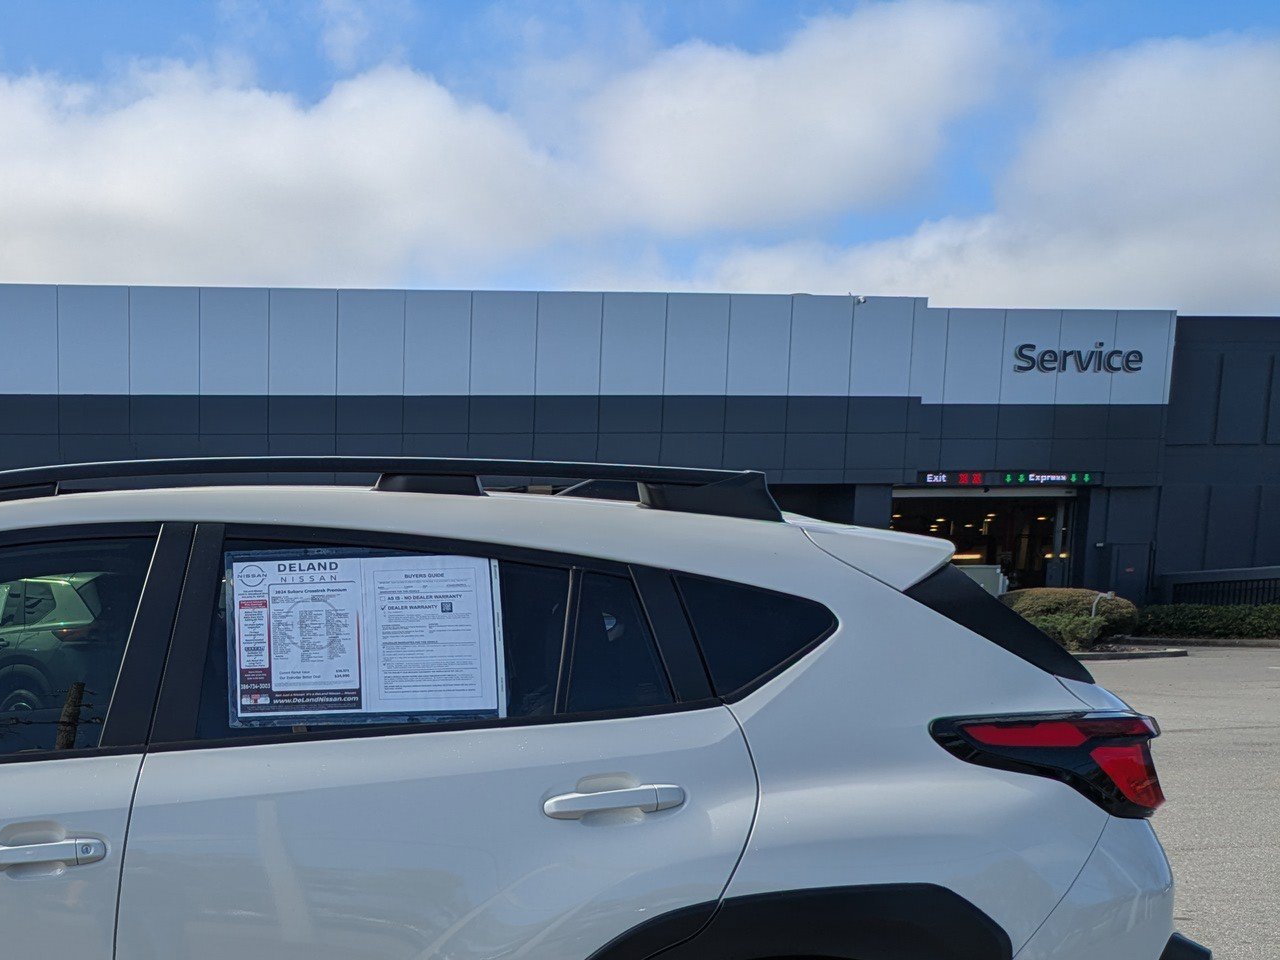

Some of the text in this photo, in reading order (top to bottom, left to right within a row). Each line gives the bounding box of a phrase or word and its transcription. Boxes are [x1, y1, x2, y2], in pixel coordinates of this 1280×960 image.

[1013, 341, 1144, 373] Service
[926, 472, 947, 483] Exit
[277, 561, 339, 573] DELAND
[280, 574, 337, 583] NISSAN
